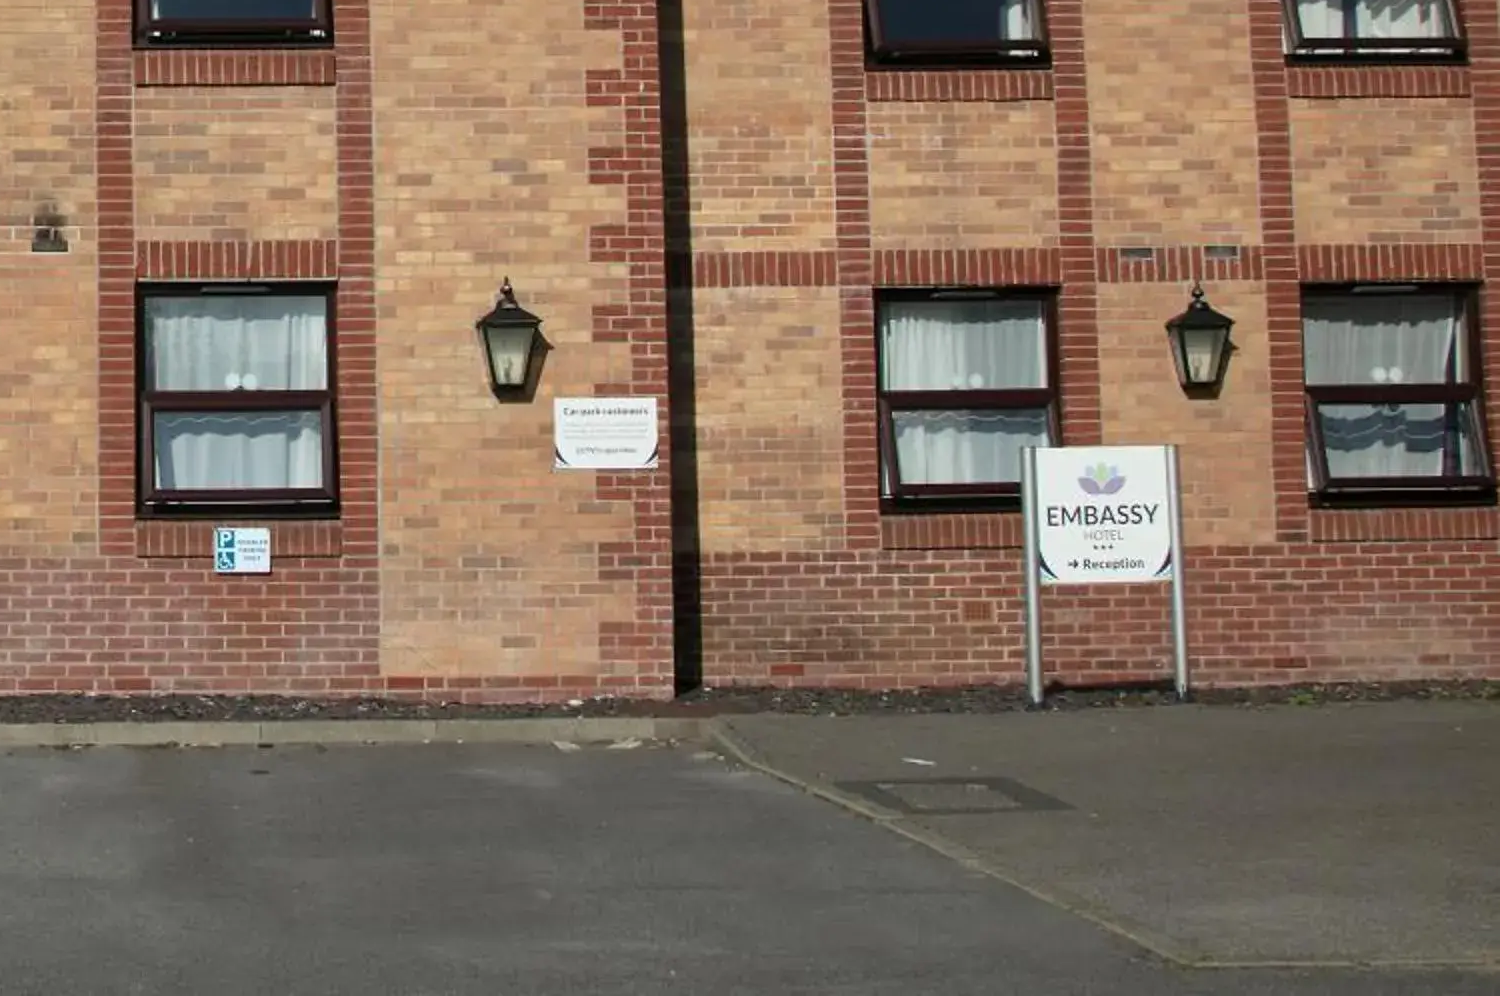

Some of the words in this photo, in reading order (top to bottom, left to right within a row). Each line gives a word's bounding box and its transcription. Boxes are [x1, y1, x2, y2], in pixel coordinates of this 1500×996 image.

[1046, 504, 1159, 526] EMBASSY
[220, 531, 232, 548] P
[1084, 529, 1125, 541] HOTEL
[1083, 558, 1145, 571] Reception
